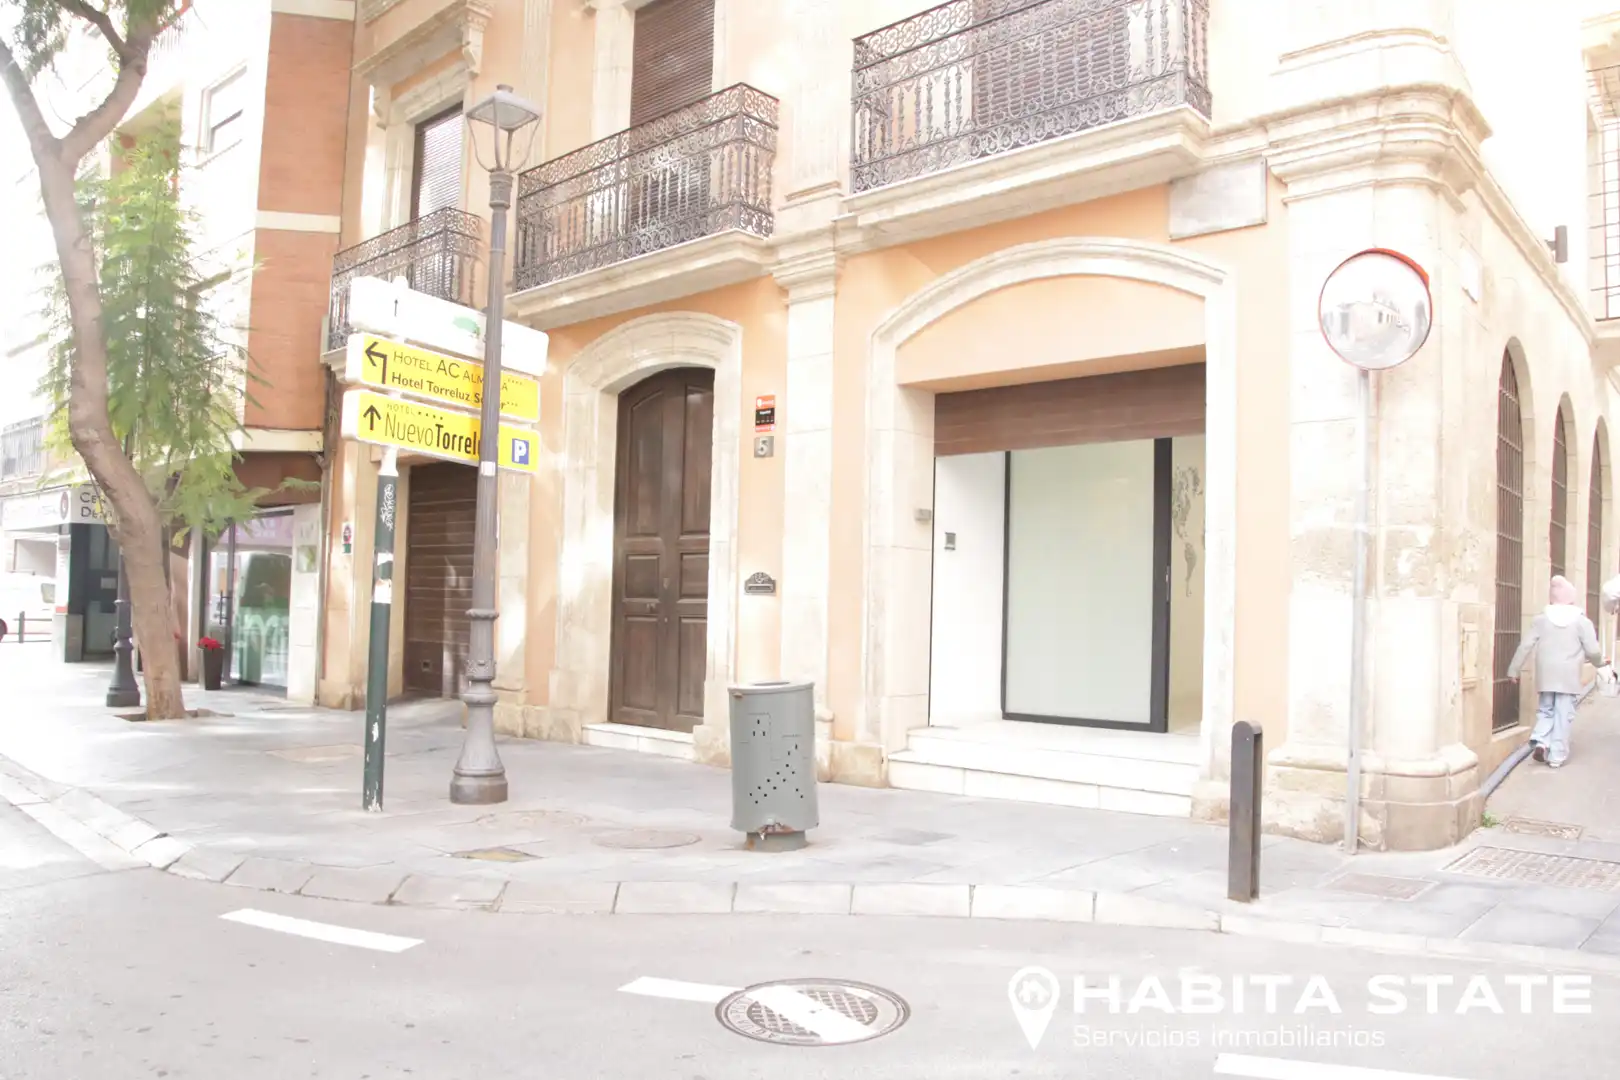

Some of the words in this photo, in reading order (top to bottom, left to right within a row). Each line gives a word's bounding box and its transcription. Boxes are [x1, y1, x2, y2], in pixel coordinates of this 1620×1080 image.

[393, 350, 433, 372] HOTEL
[435, 359, 461, 379] AC
[391, 371, 424, 391] Hotel
[426, 380, 471, 402] Torreluz
[386, 403, 415, 415] HOTEL
[757, 437, 769, 456] 5
